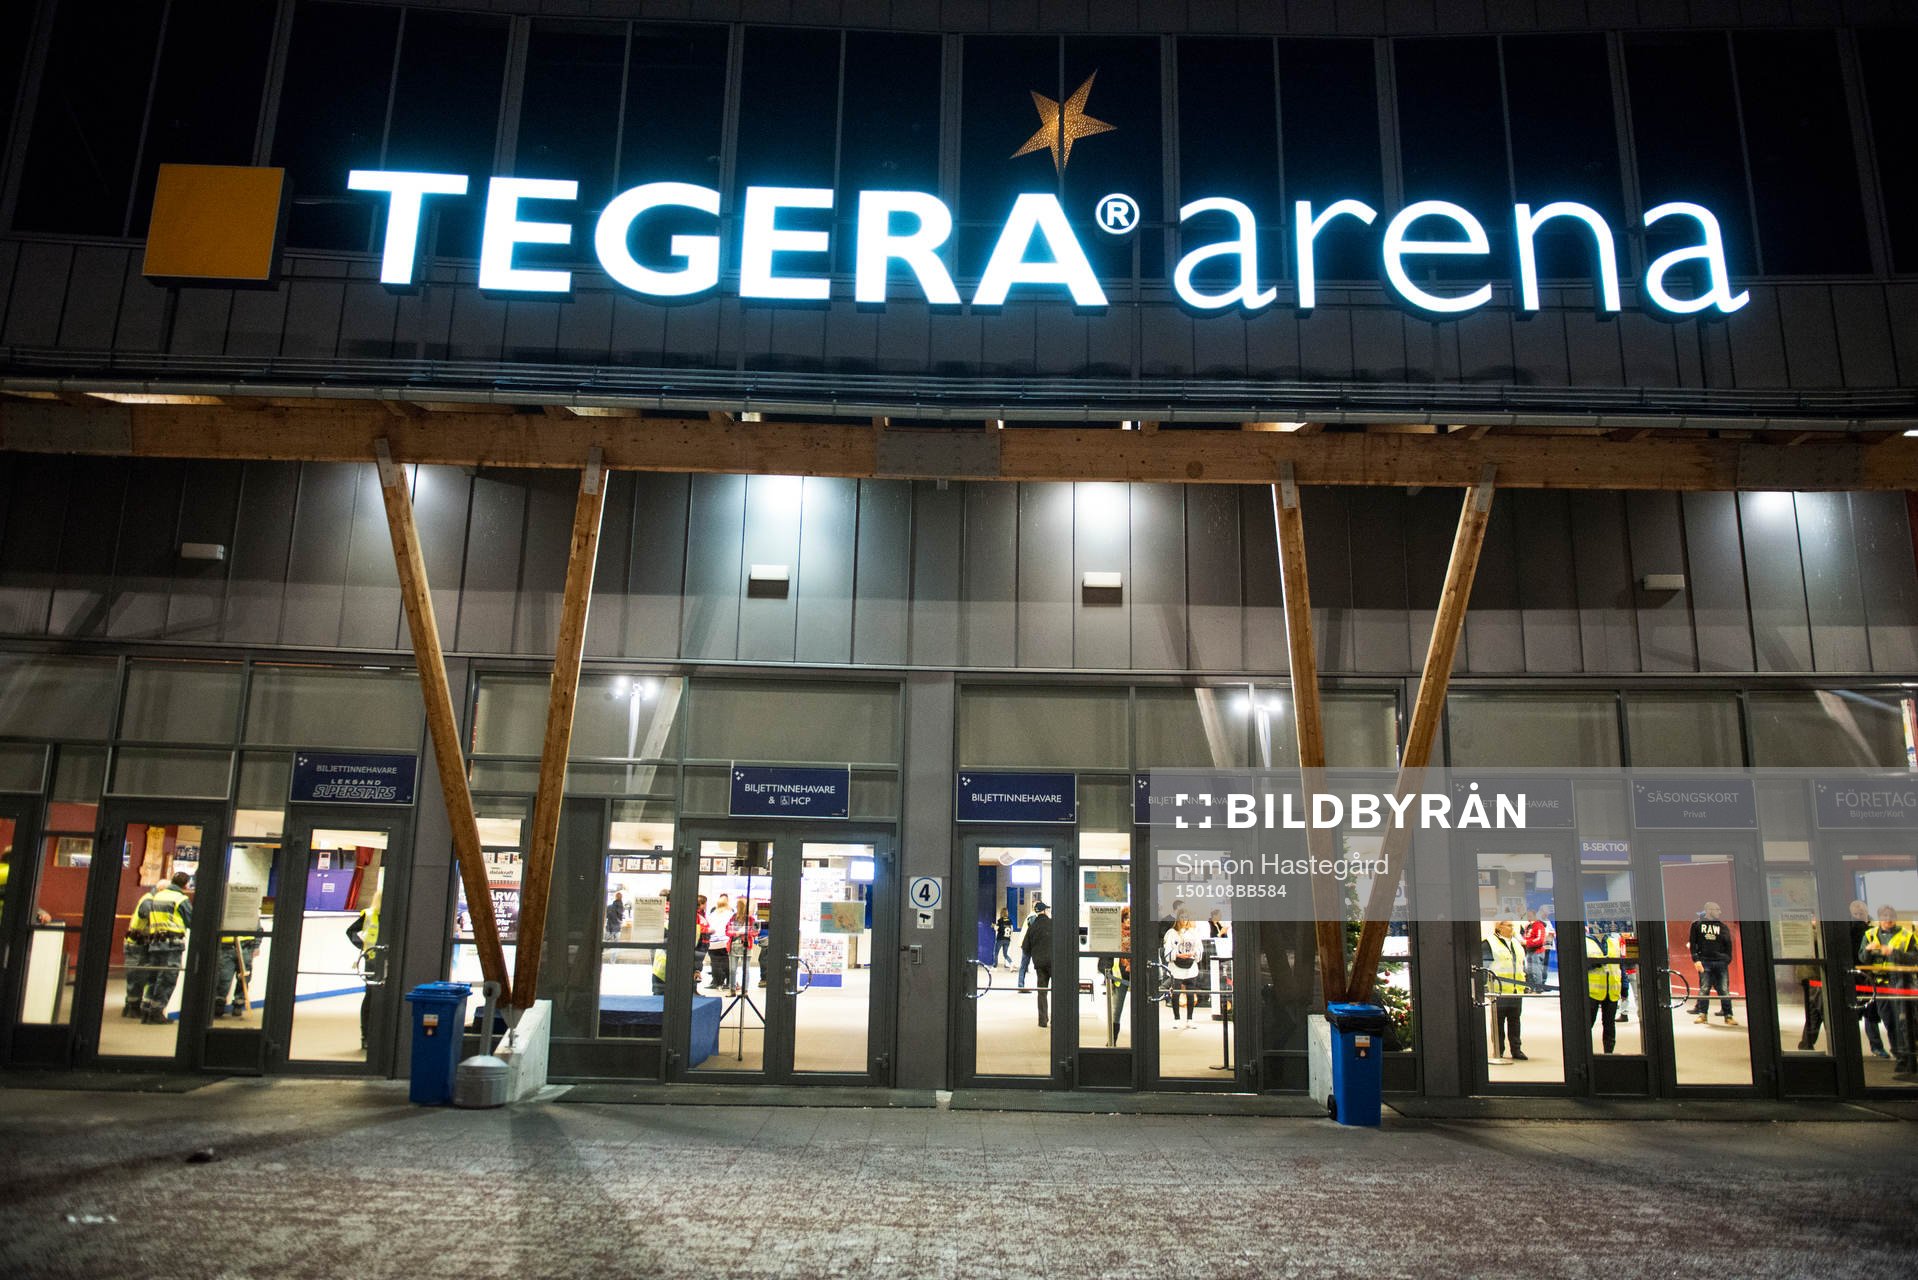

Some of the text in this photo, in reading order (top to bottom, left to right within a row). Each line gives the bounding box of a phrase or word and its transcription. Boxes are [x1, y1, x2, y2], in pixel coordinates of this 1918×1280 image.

[1173, 196, 1750, 315] arena
[316, 764, 398, 775] BILJETTINNEHAVARE
[312, 784, 397, 800] SUPERSTARS
[744, 783, 836, 794] BILJETTINNEHAVARE
[768, 796, 812, 806] & HCP
[971, 793, 1063, 803] BILJETTINNEHAVARE
[1647, 790, 1740, 804] SÄSONGSKORT
[1835, 788, 1917, 808] FÖRETAG
[1683, 810, 1707, 818] Privat
[918, 883, 931, 902] 4
[1701, 923, 1720, 935] RAW
